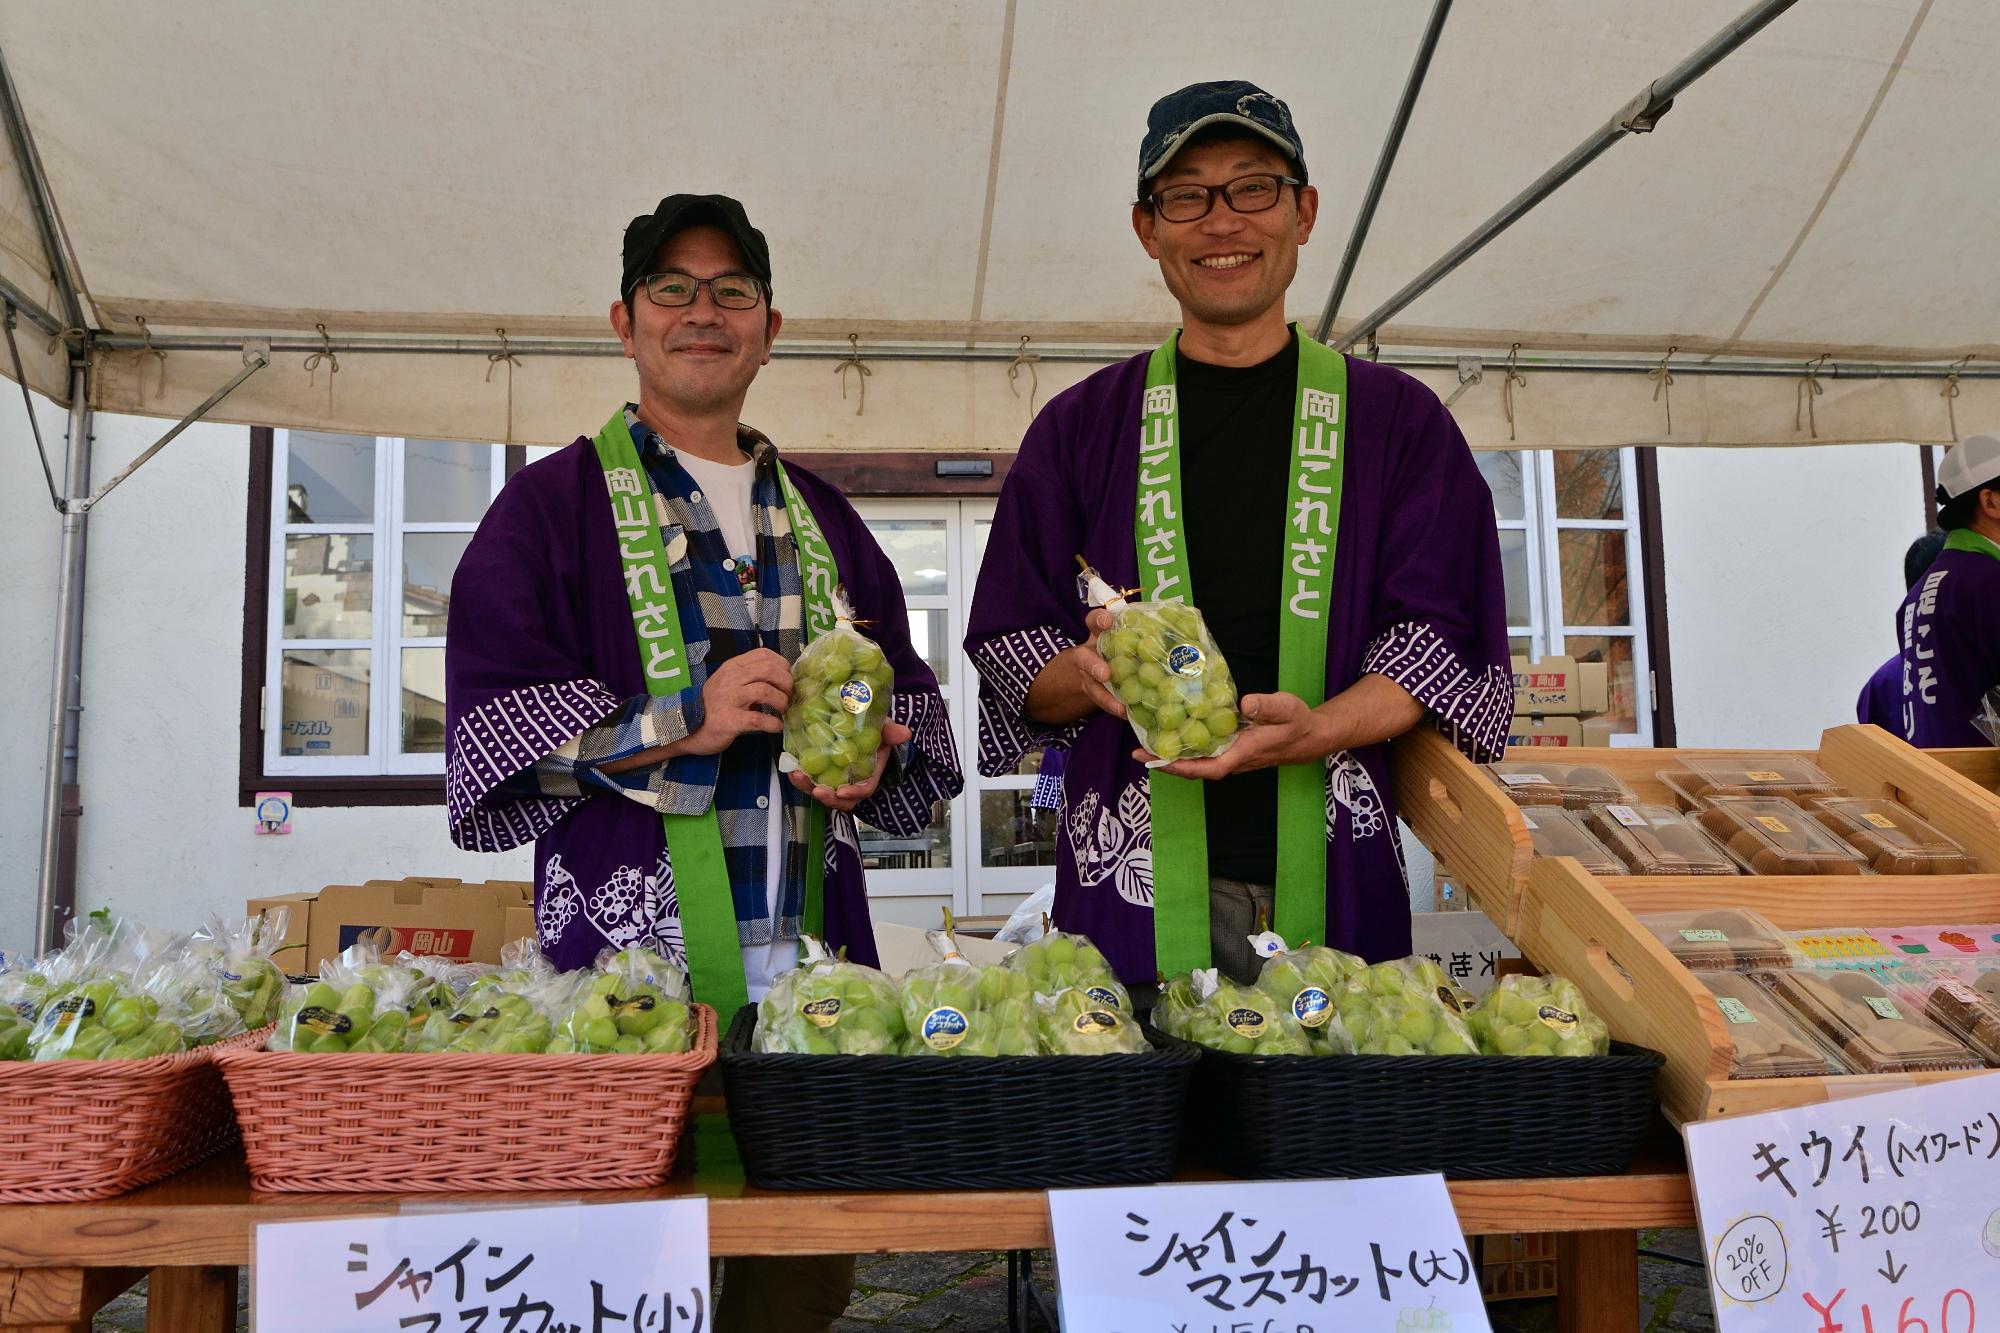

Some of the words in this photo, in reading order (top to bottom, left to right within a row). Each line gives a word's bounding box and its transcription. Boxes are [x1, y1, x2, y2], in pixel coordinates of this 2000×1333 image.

[1139, 383, 1184, 603] 岡山これさと
[1289, 387, 1340, 620] 岡山これさと
[604, 467, 681, 679] 岡山これさと
[1536, 674, 1558, 687] 岡山
[410, 930, 455, 955] 岡山
[347, 1237, 534, 1310] シャイン
[1125, 1211, 1286, 1276] シャイン
[1186, 1242, 1469, 1311] マスカット(大)
[1726, 1234, 1764, 1271] 20%
[1741, 1259, 1771, 1294] OFF
